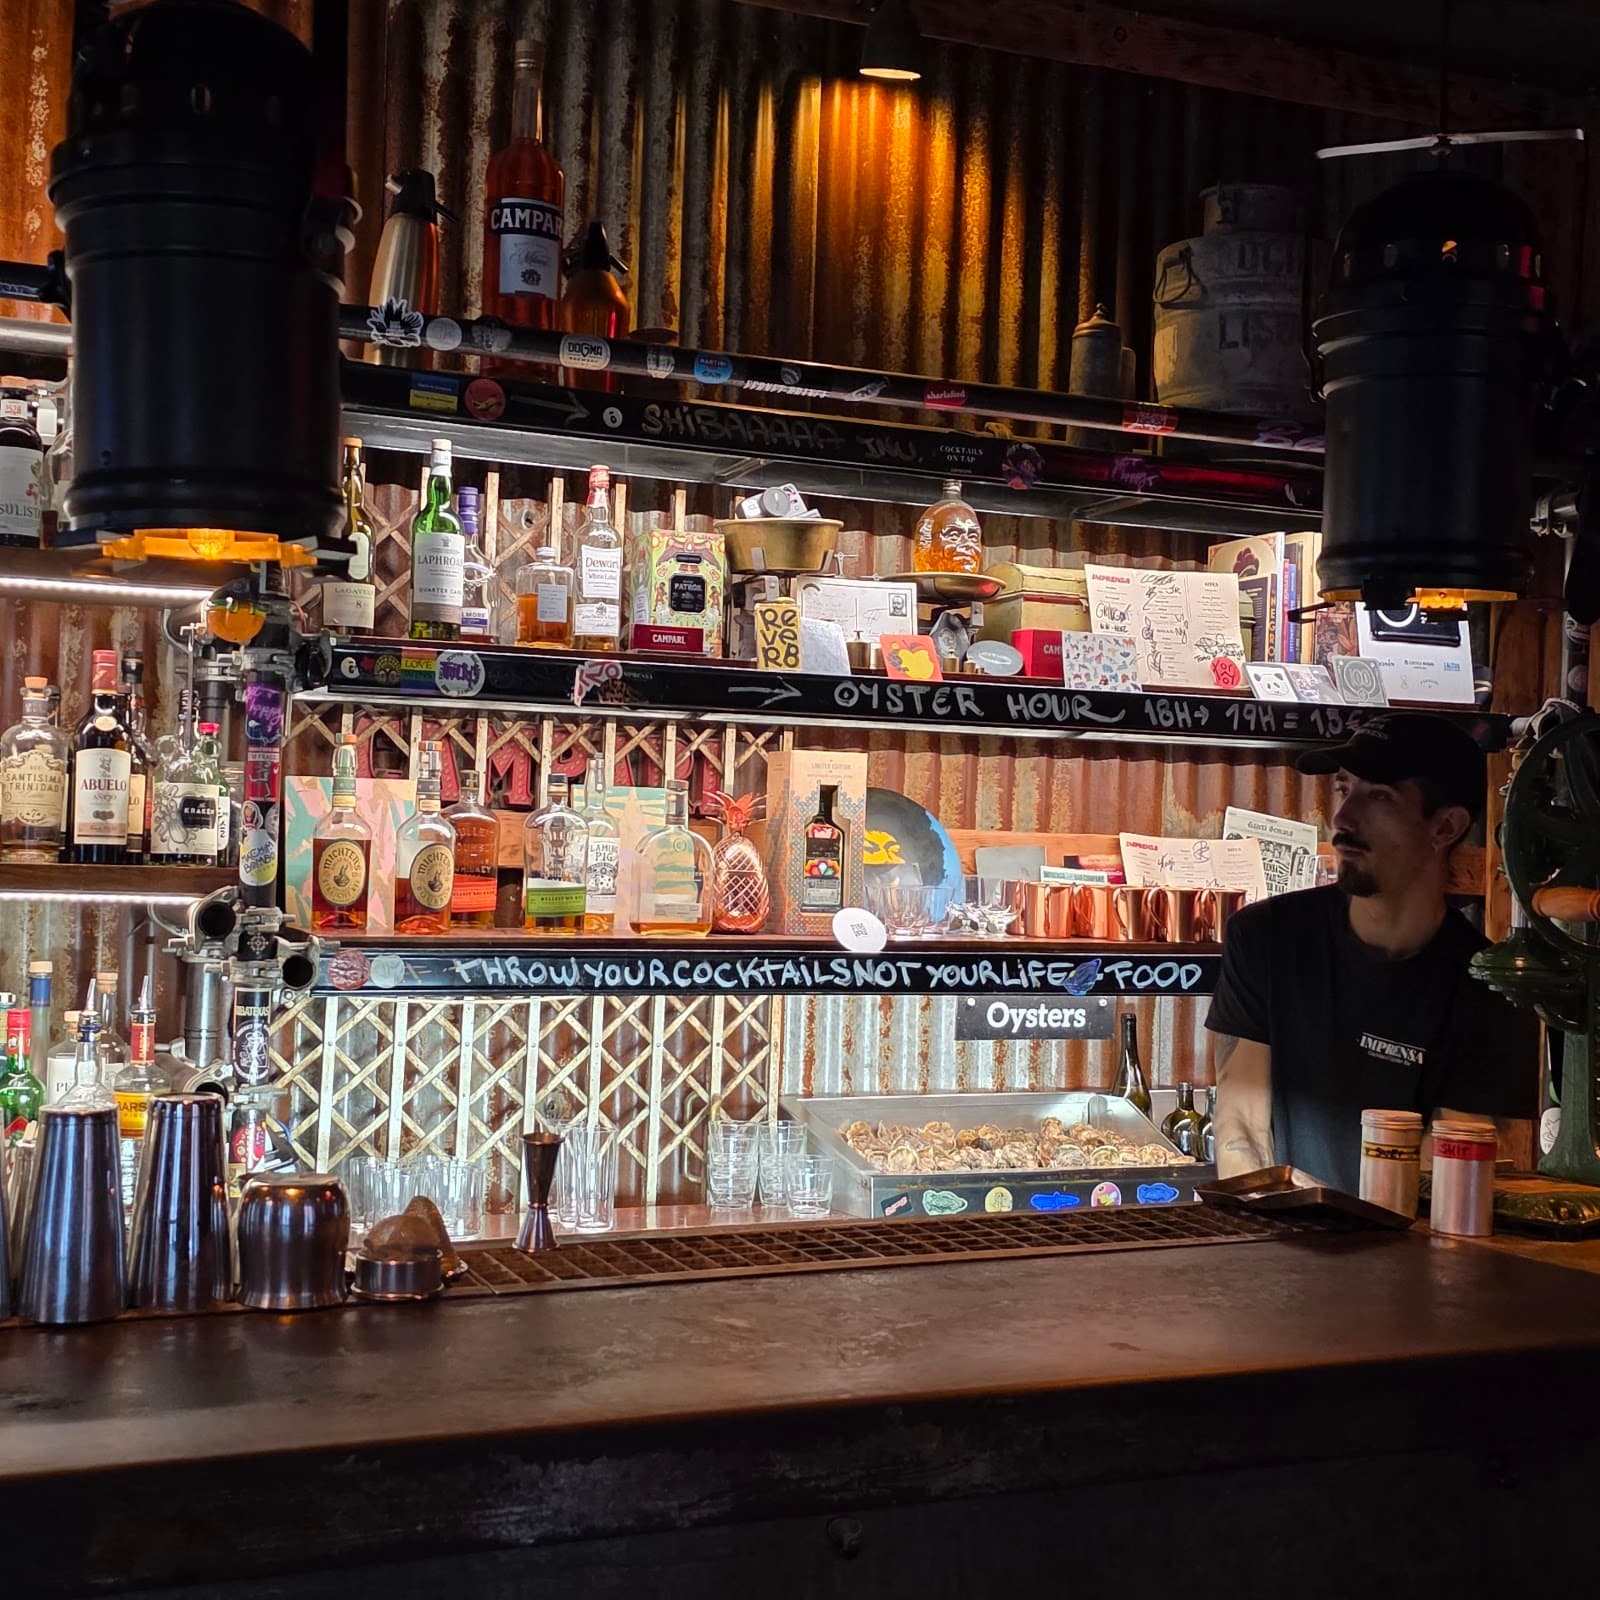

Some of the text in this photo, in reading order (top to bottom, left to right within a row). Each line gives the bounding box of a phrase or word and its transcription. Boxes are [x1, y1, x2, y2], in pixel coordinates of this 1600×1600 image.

[491, 207, 563, 238] CAMPAR
[568, 342, 602, 357] DOGMA
[939, 444, 983, 456] COCKTAILS
[405, 660, 432, 670] LOVE
[834, 680, 985, 718] OYSTER
[1006, 693, 1127, 724] HOUR
[10, 782, 59, 792] TRINIDAD
[81, 778, 127, 791] ABUELO
[596, 852, 613, 862] PIG
[453, 956, 580, 987] THROW
[585, 960, 668, 987] YOUR
[854, 958, 922, 988] NOT
[925, 960, 1002, 986] YOUR
[1104, 960, 1202, 990] FOOD
[987, 1001, 1086, 1033] Oysters
[1360, 1035, 1424, 1065] IMPRENSA
